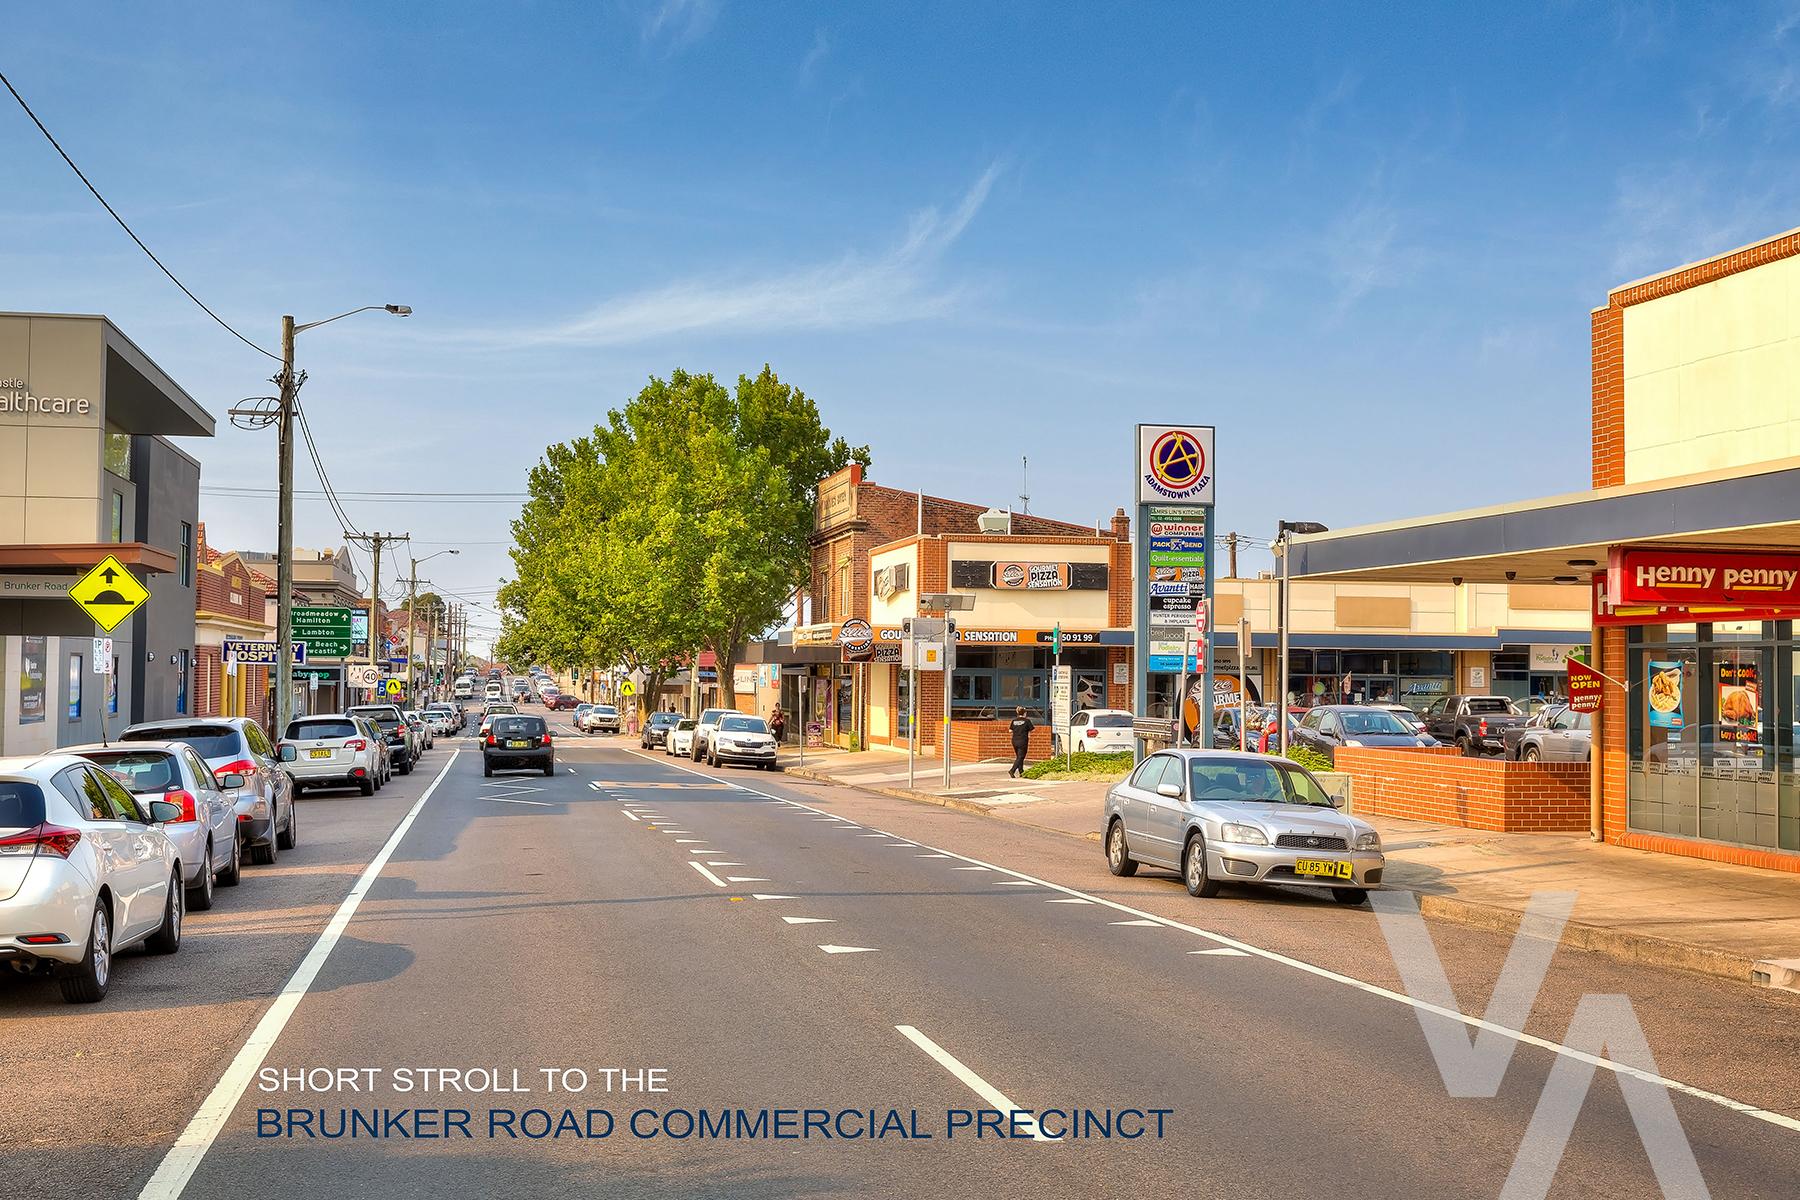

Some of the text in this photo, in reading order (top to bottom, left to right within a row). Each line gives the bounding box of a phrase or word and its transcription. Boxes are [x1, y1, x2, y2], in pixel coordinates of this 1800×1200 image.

[1145, 474, 1211, 499] ADAMSTOWN PLAZA
[1164, 523, 1203, 532] winner
[1031, 571, 1058, 581] PIZZA
[1182, 570, 1200, 578] PIZZA
[1637, 566, 1798, 591] Henny penny
[4, 581, 68, 590] Brunker Road
[1028, 579, 1063, 588] SENSATION
[1163, 597, 1191, 605] cupcake
[964, 631, 1017, 642] SENSATION
[1072, 633, 1081, 642] 91
[1083, 633, 1093, 642] 99
[227, 642, 300, 652] VETERINY
[228, 651, 301, 662] OSPIL
[877, 648, 900, 657] PIZZA
[365, 673, 376, 681] 40
[1571, 681, 1600, 689] OPEN
[1573, 695, 1598, 703] Henny
[1297, 861, 1308, 871] CU
[1309, 862, 1320, 872] 85
[1339, 864, 1348, 876] L
